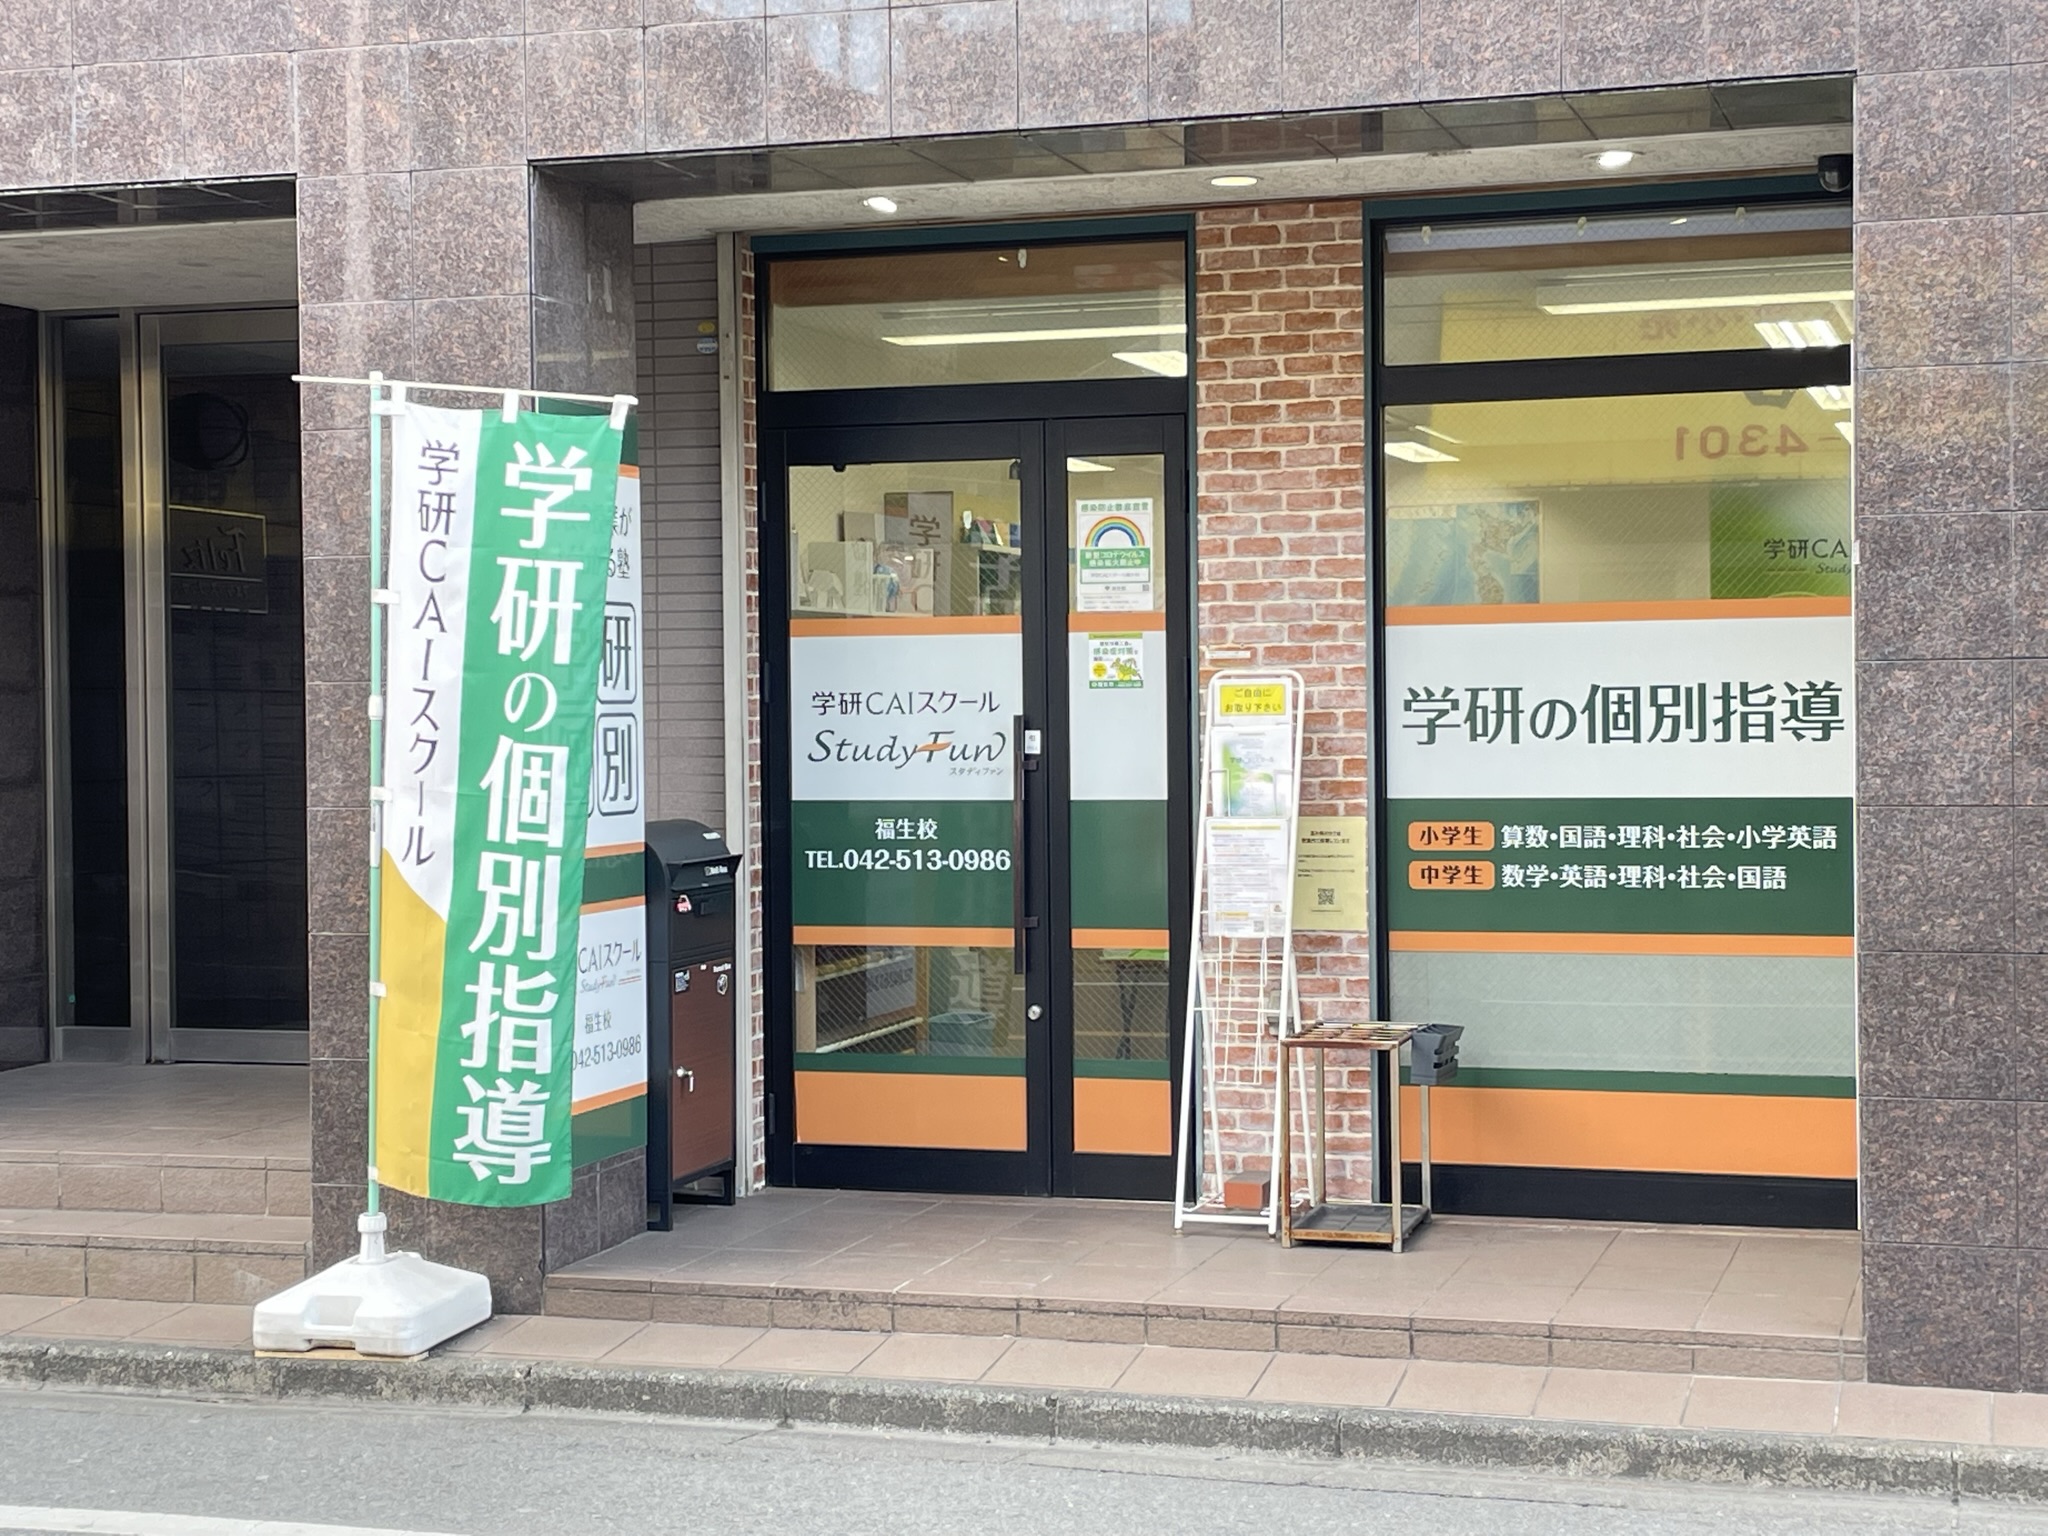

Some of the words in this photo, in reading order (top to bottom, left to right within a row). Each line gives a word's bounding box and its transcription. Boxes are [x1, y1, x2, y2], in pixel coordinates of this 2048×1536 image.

[402, 438, 461, 866] 学研CAIスクール
[811, 690, 1001, 716] 学研CAIスクール
[1234, 687, 1273, 698] ご自由に
[1401, 679, 1846, 745] 学研の個別指導
[949, 766, 1005, 776] スタディファン
[452, 440, 594, 1185] 学研の個別指導
[874, 817, 938, 840] 福生校
[1419, 824, 1484, 847] 小学生
[1500, 823, 1838, 850] 算数・国語・理科・社会・小学英語
[804, 847, 1012, 871] TEL.042-513-0986
[1419, 863, 1485, 886] 中学生
[1500, 863, 1788, 890] 数学・英語・理科・社会・国語
[577, 938, 642, 975] CAIスクール
[584, 1009, 612, 1035] 福生校
